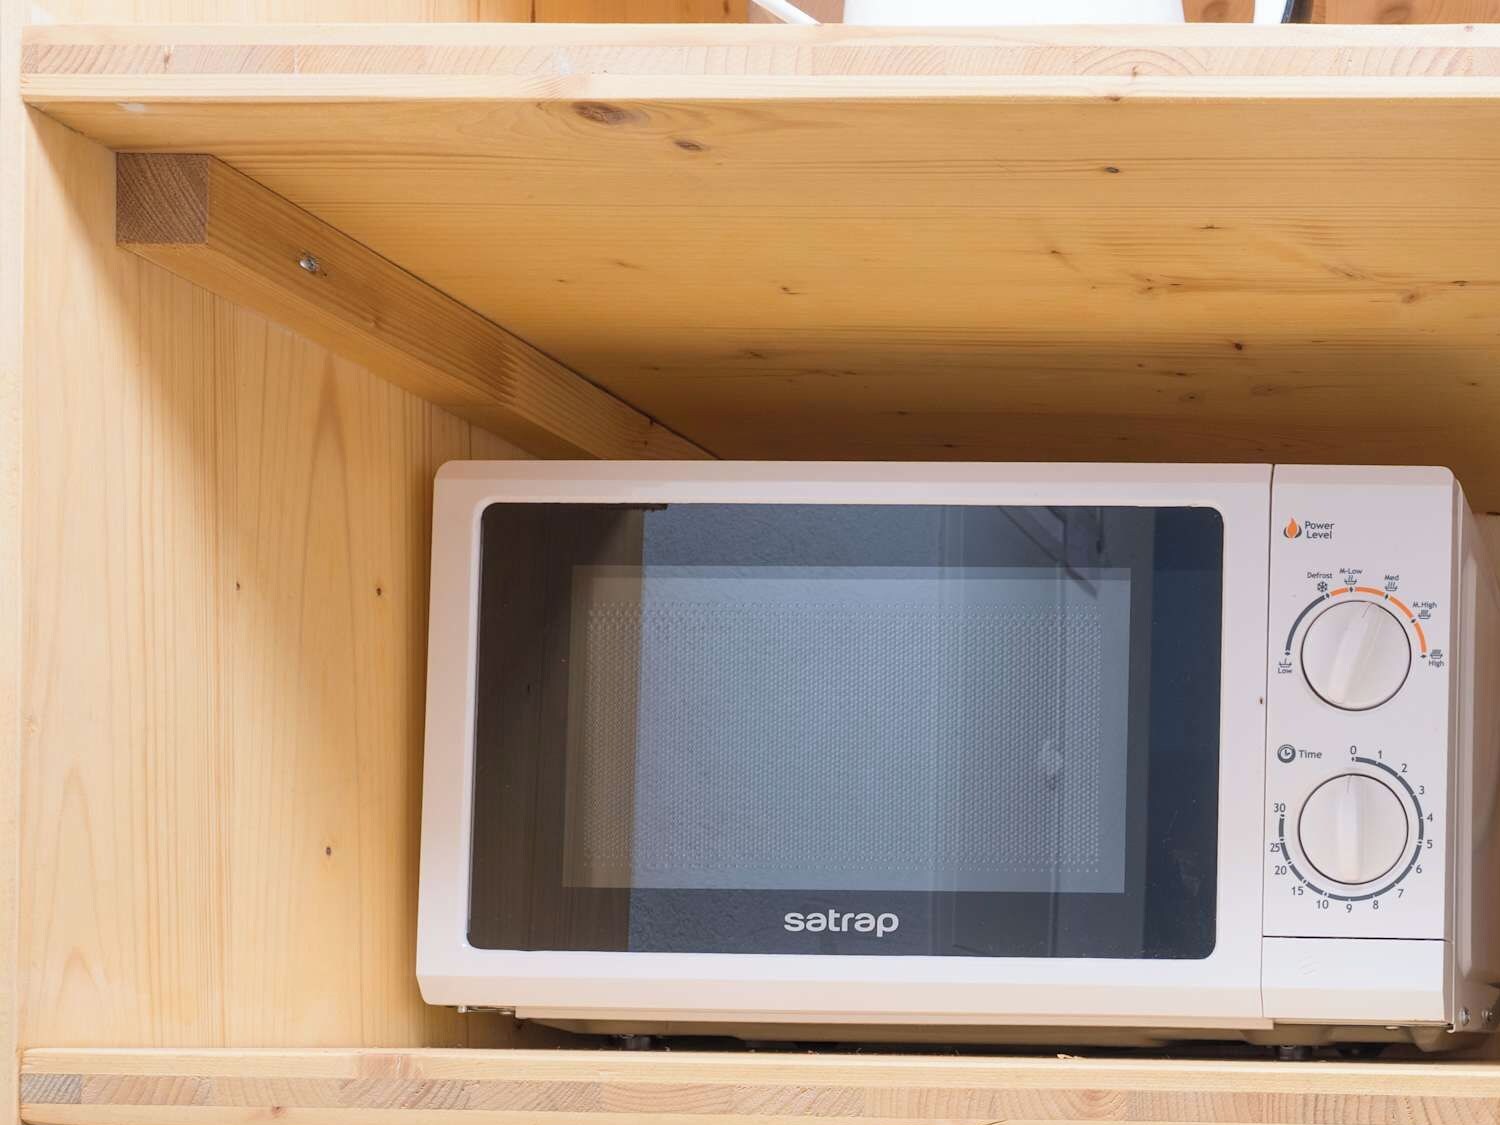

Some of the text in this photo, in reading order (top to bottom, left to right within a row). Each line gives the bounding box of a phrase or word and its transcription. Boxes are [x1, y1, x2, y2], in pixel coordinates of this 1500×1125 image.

[1304, 520, 1335, 530] Power
[1306, 530, 1333, 540] Level
[1384, 574, 1400, 582] Med
[1428, 660, 1444, 668] High
[1277, 667, 1293, 675] Low
[1299, 750, 1323, 759] Time
[1350, 746, 1357, 755] 0
[1377, 750, 1383, 759] 1
[1401, 764, 1408, 773] 2
[1419, 786, 1425, 795] 3
[1273, 803, 1286, 813] 30
[1426, 813, 1433, 822] 4
[1270, 843, 1281, 852] 25
[1427, 840, 1433, 849] 5
[1274, 866, 1287, 875] 20
[1416, 865, 1422, 874] 6
[1291, 887, 1304, 896] 15
[1397, 889, 1404, 899] 7
[1316, 900, 1329, 909] 10
[1346, 904, 1353, 913] 9
[1372, 900, 1379, 910] 8
[784, 909, 899, 938] satrap
